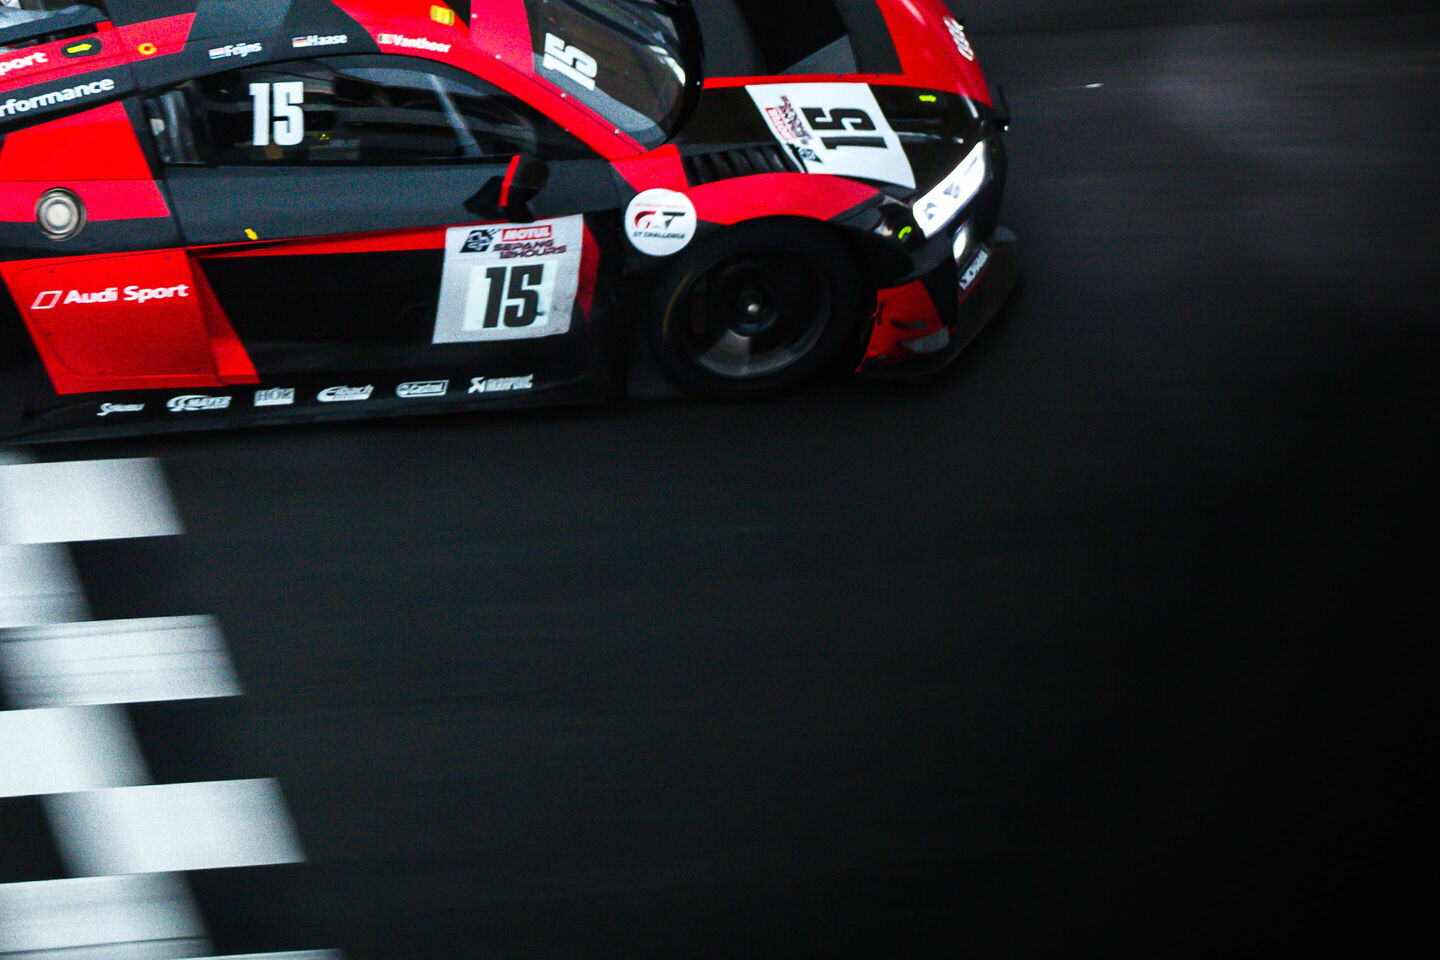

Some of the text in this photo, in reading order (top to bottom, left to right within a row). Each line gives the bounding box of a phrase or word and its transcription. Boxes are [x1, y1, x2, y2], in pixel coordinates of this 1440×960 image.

[306, 34, 348, 47] Haase
[392, 34, 451, 53] Vanthoor
[543, 32, 598, 91] 15
[249, 81, 304, 146] 15
[800, 107, 888, 150] 15
[503, 226, 551, 241] MOTUL
[492, 239, 554, 252] SEPANG
[63, 284, 189, 304] Audi Sport
[483, 263, 544, 328] 15
